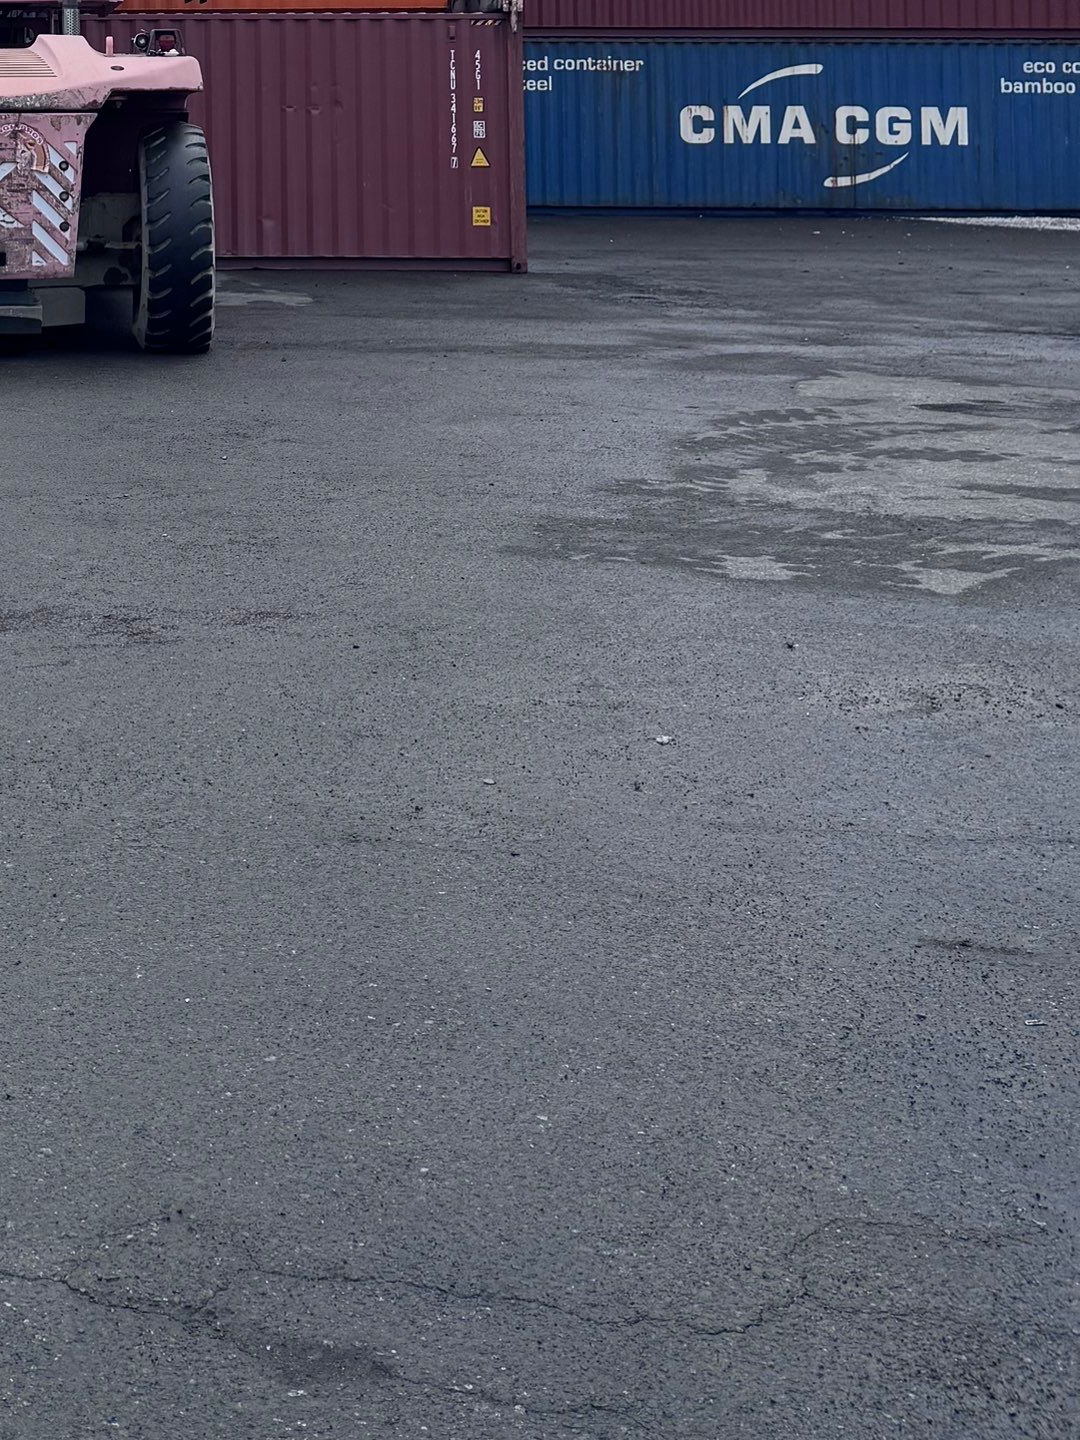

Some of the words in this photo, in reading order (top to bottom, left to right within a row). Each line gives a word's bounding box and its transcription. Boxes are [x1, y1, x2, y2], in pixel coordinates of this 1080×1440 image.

[522, 56, 548, 71] ed
[553, 56, 644, 71] container
[1023, 61, 1056, 73] eco
[522, 76, 552, 91] eel
[1000, 77, 1076, 94] bamboo
[679, 105, 816, 144] CMA
[835, 106, 969, 146] CGM
